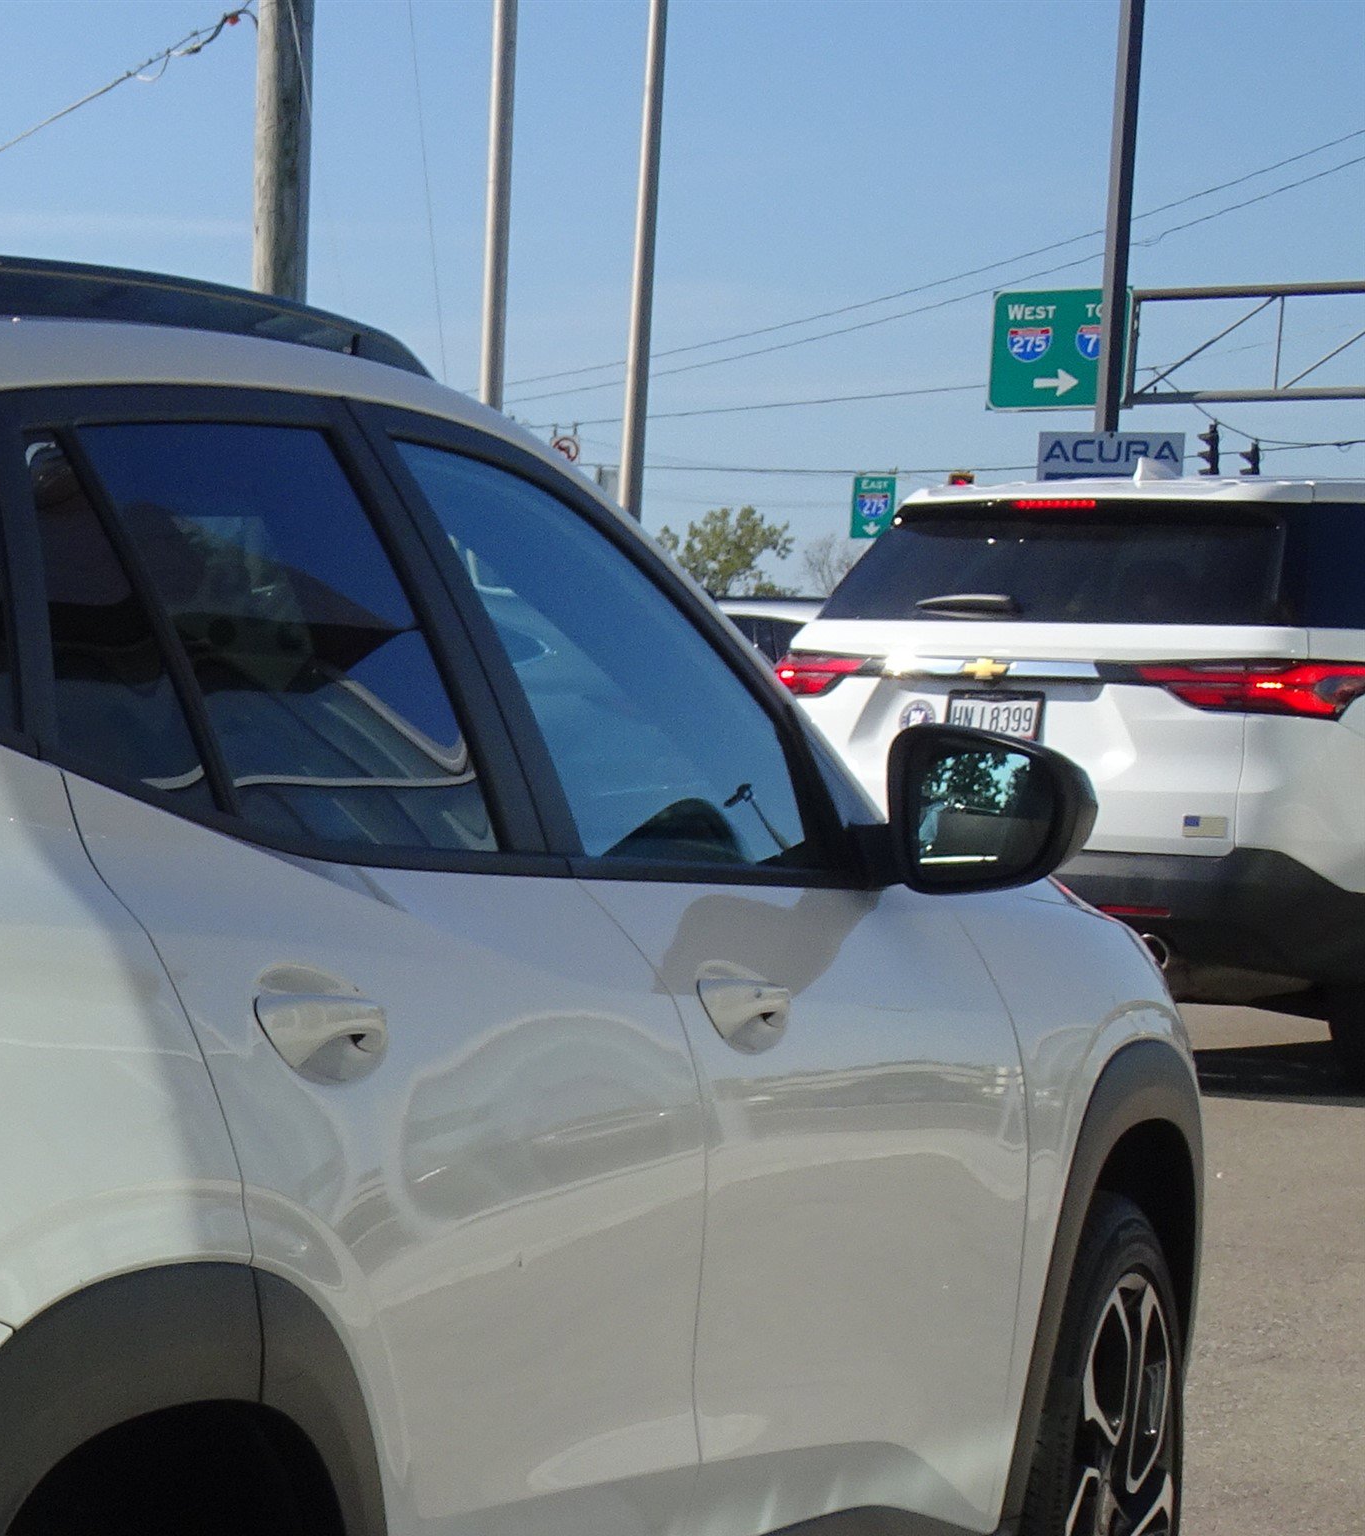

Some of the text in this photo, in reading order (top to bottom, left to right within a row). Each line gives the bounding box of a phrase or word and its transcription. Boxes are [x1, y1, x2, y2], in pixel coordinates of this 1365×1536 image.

[1008, 304, 1056, 320] WEST
[1012, 335, 1047, 353] 275
[1043, 439, 1179, 463] ACURA
